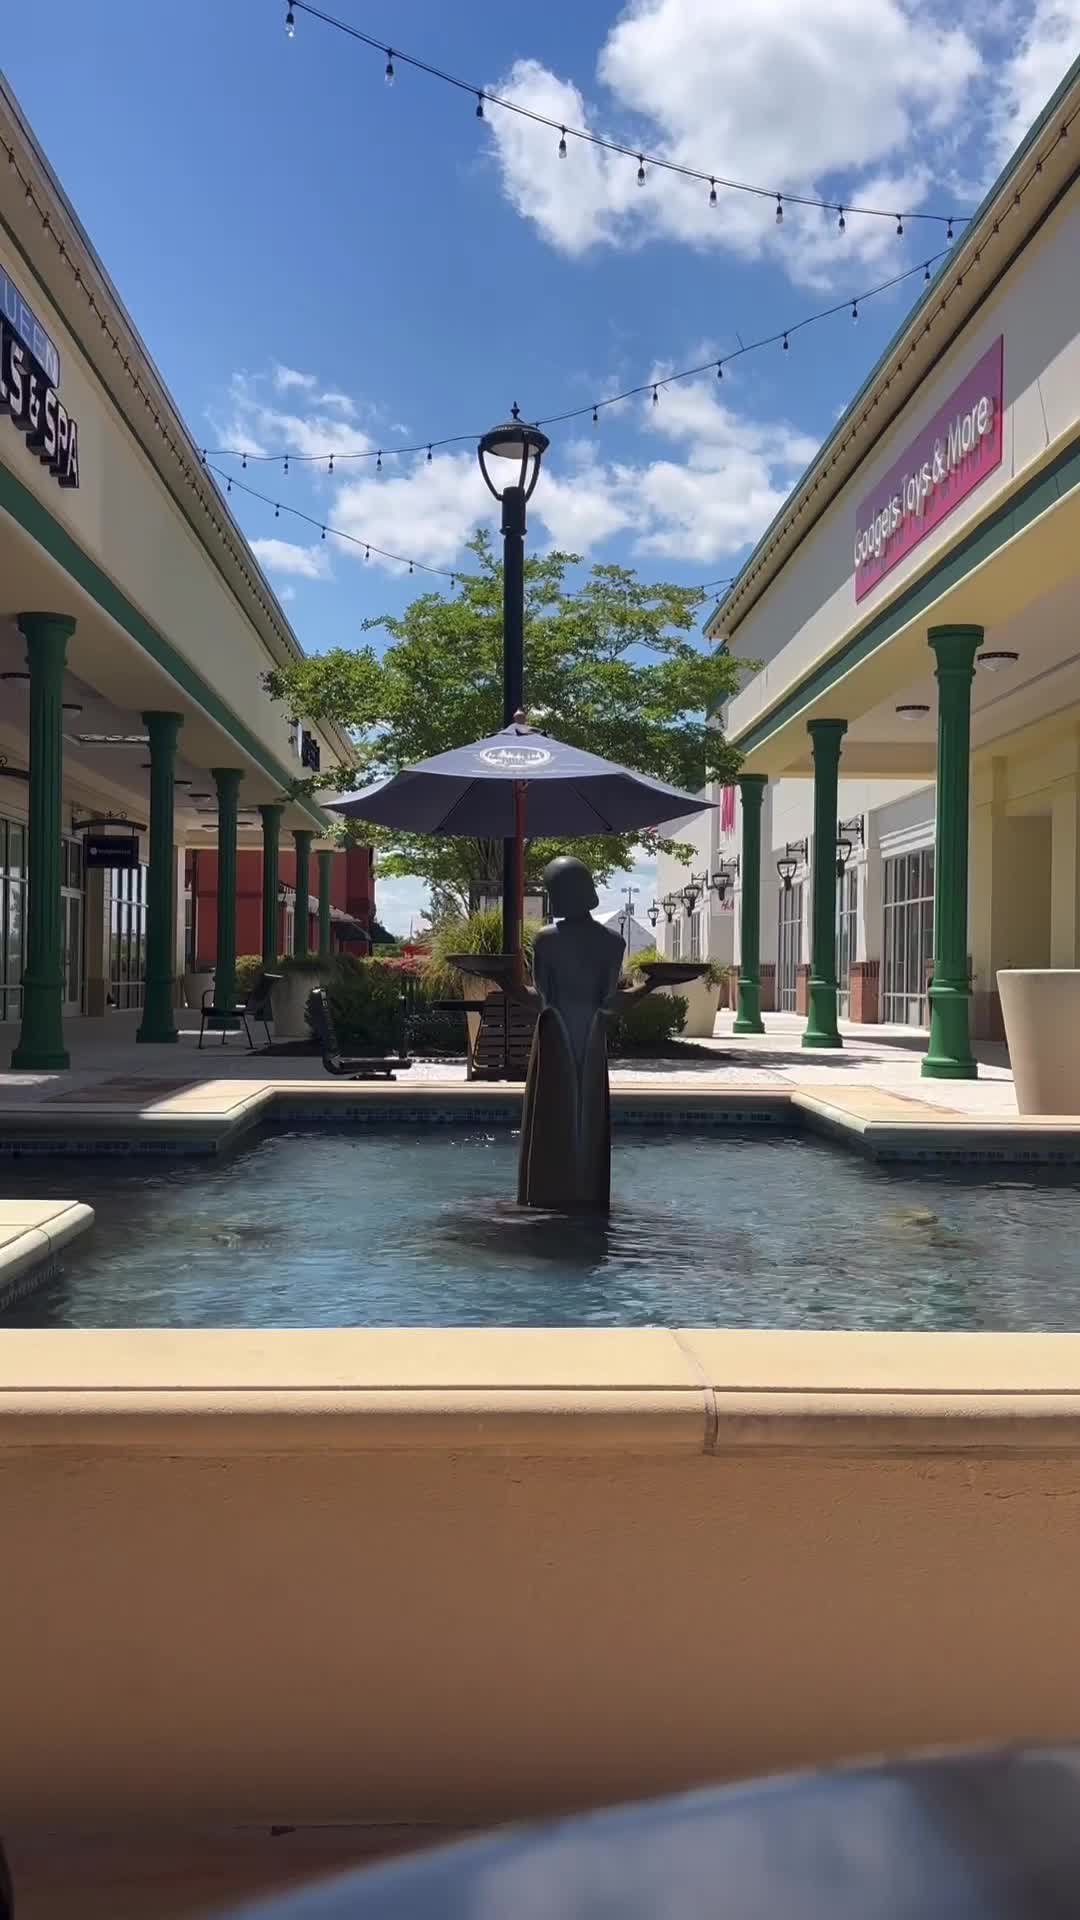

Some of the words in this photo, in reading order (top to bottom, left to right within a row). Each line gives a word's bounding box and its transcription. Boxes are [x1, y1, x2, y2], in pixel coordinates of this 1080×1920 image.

[854, 495, 901, 567] Gadgets
[902, 463, 932, 518] Toys
[932, 438, 945, 484] &
[946, 396, 989, 470] More
